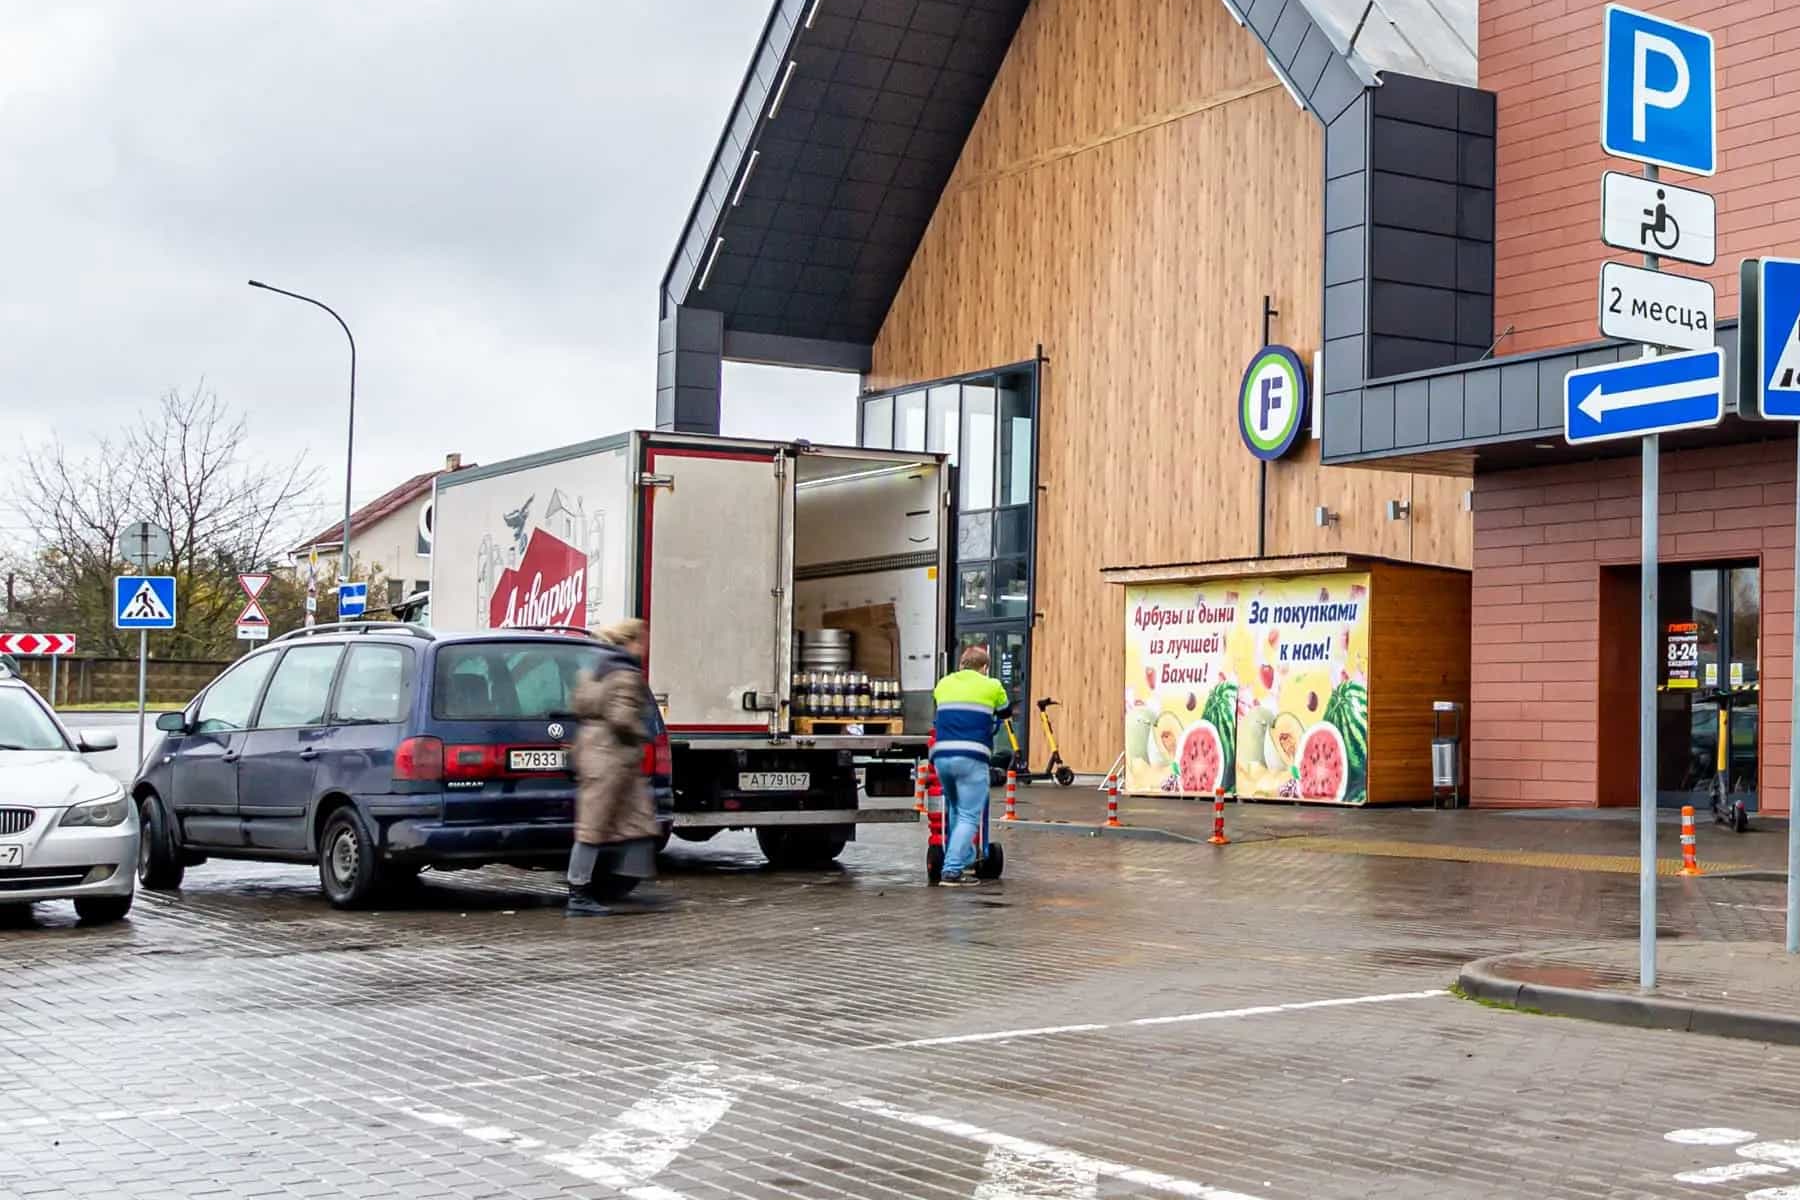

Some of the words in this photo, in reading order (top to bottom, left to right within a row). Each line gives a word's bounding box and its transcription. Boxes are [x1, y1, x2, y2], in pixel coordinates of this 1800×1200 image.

[1632, 29, 1690, 143] P
[1609, 286, 1622, 314] 2
[1631, 298, 1708, 331] месца
[1260, 375, 1283, 431] F
[1134, 605, 1183, 631] Арбузы
[1186, 612, 1195, 625] и
[1199, 602, 1235, 624] дыни
[1249, 600, 1269, 625] За
[1273, 601, 1358, 629] покупками
[1150, 638, 1164, 655] из
[1167, 632, 1219, 659] лучшей
[1280, 644, 1288, 661] к
[1292, 636, 1331, 661] нам!
[1668, 643, 1698, 660] 8-24
[1161, 662, 1208, 684] Бахчи!
[524, 752, 558, 767] 7833
